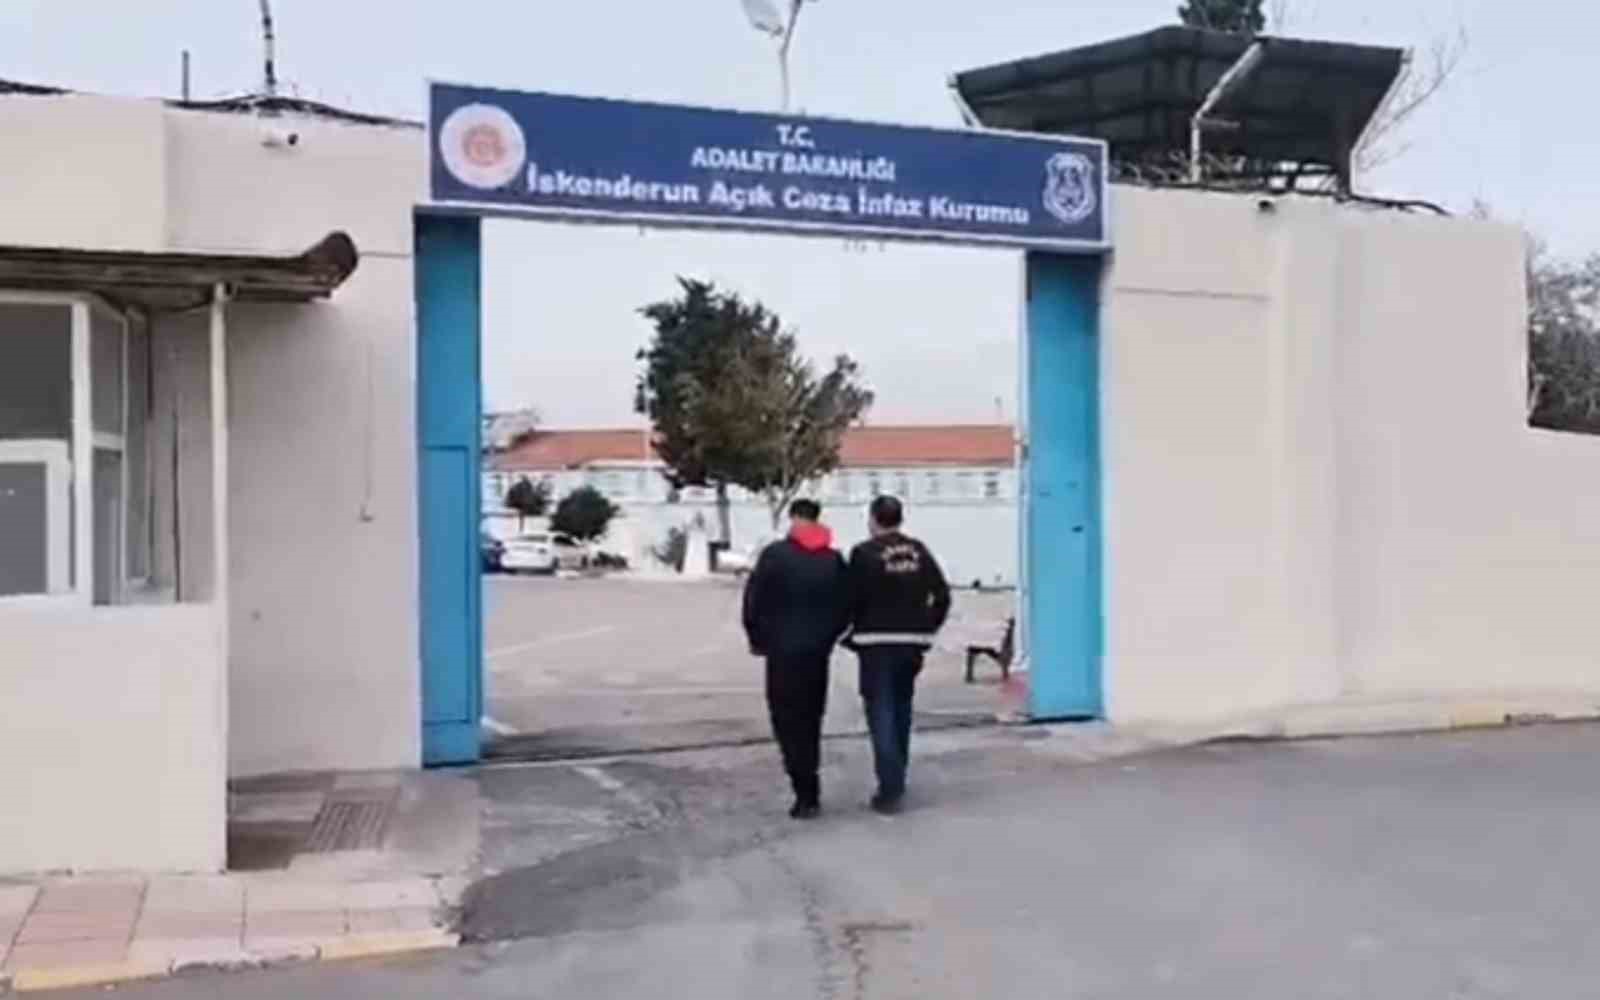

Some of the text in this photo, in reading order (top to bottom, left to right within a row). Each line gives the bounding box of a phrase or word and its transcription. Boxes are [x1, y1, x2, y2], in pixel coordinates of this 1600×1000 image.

[777, 125, 814, 147] T.C.
[692, 147, 895, 182] ADALET BAKANLIĞI
[526, 163, 1030, 225] İskenderun Açık Ceza İnfaz Kurumu
